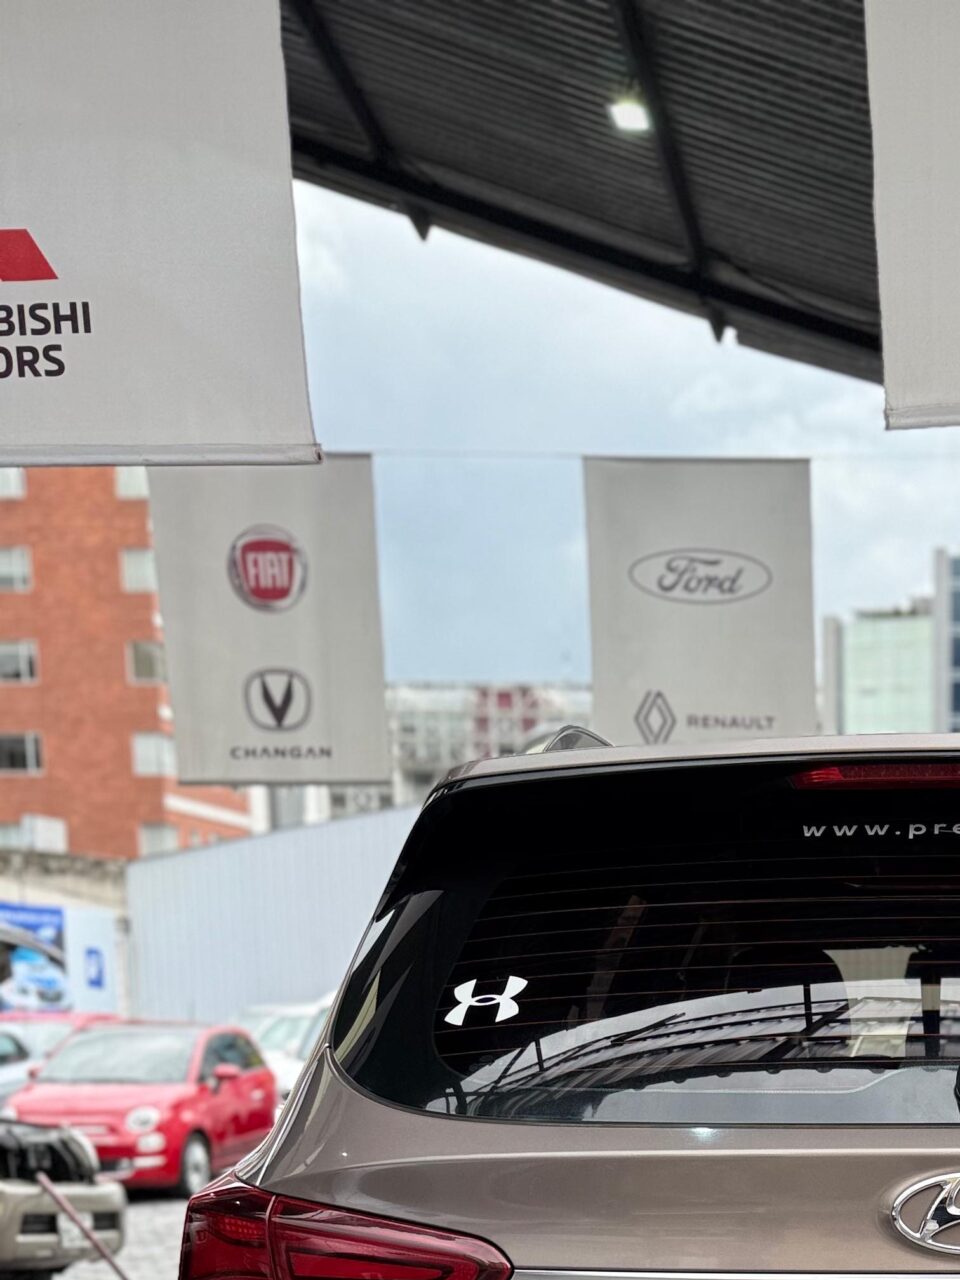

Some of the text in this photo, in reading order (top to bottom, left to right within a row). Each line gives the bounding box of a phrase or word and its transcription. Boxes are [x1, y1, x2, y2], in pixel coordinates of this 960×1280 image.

[0, 301, 92, 337] BISHI
[246, 551, 291, 590] FIAT
[656, 554, 745, 595] Ford
[686, 714, 776, 731] RENAULT
[229, 746, 333, 760] CHANGAN
